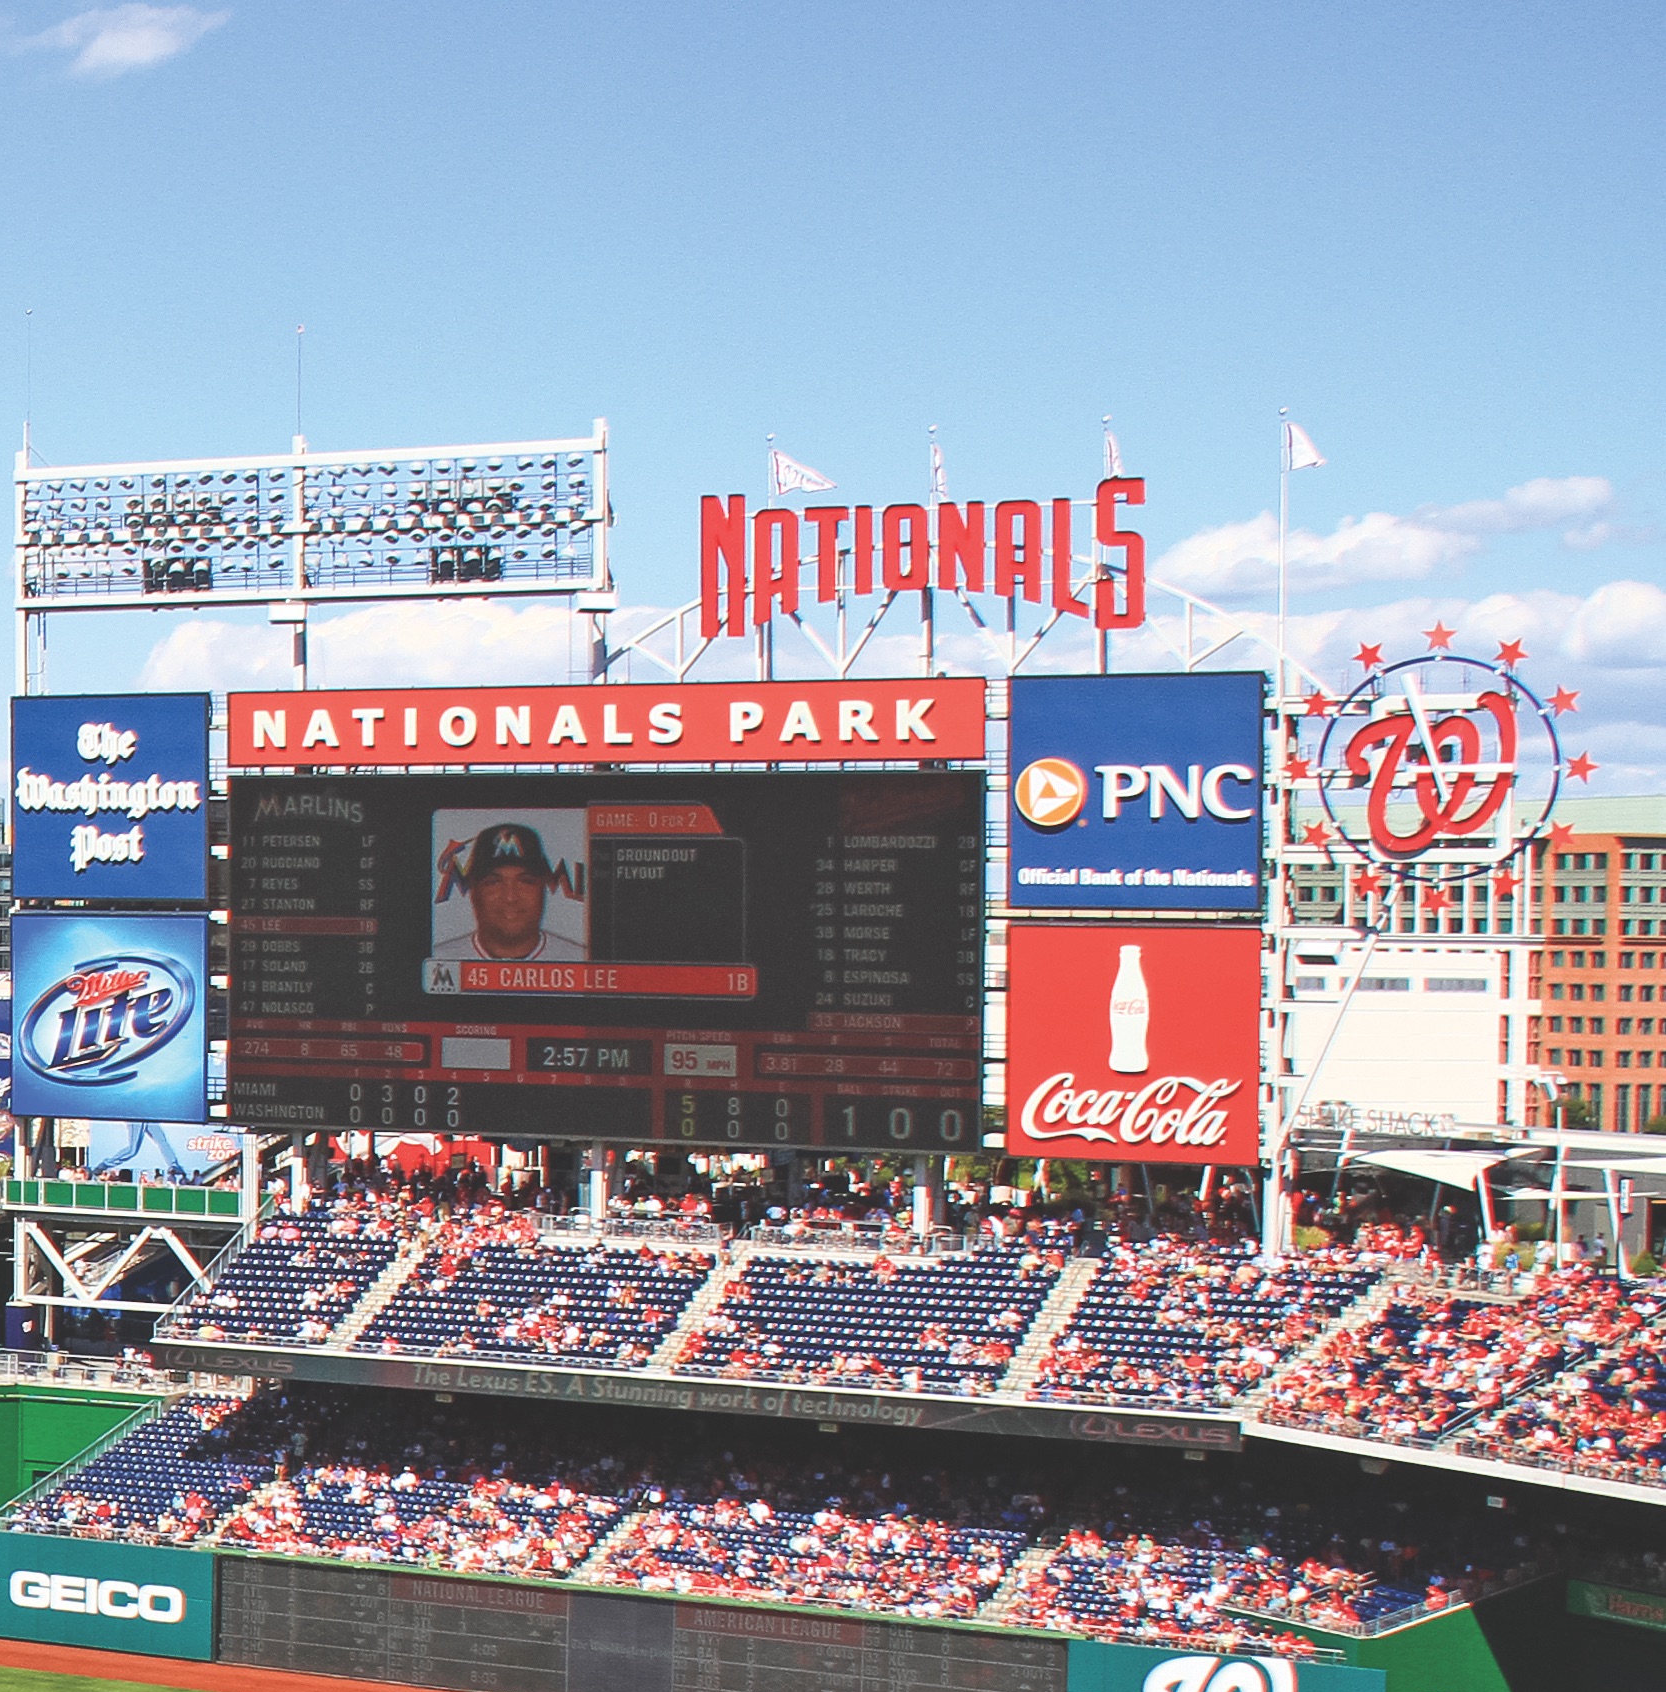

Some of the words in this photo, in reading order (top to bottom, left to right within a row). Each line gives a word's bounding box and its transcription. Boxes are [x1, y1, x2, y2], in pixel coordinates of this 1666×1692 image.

[699, 476, 1145, 638] NATIONALS
[251, 700, 684, 749] NATIONALS
[729, 698, 937, 744] PARK
[77, 722, 139, 765] The
[15, 767, 202, 819] Washington
[1093, 761, 1254, 820] PNC
[253, 792, 364, 824] MARLINS
[597, 814, 638, 828] GAME:
[649, 812, 658, 827] 0
[662, 817, 684, 828] FOR
[688, 813, 697, 828] 2
[69, 824, 145, 872] Post
[262, 835, 321, 848] PETERSEN
[616, 848, 697, 863] GROUNDOUT
[844, 859, 897, 873] HARPER
[616, 867, 665, 880] FLYOUT
[1017, 867, 1078, 886] Official
[1079, 868, 1124, 886] Bank
[1125, 869, 1144, 886] of
[1144, 869, 1171, 887] the
[1172, 869, 1256, 888] Nationals
[844, 882, 893, 896] WERTH
[262, 898, 316, 911] STANTON
[844, 904, 904, 918] LAROCHE
[67, 970, 150, 1006] Miller
[467, 969, 488, 987] 45
[499, 969, 575, 988] CARLOS
[583, 971, 618, 990] LEE
[727, 973, 749, 992] 1B
[844, 971, 909, 985] ESPINOSA
[45, 988, 174, 1071] Lite
[542, 1047, 588, 1067] 2:57
[597, 1047, 630, 1068] PM
[671, 1051, 698, 1071] 95
[705, 1059, 732, 1071] MPH
[234, 1082, 277, 1097] MIAMI
[234, 1103, 325, 1120] WASHINGTON
[681, 1096, 695, 1114] 5
[727, 1097, 741, 1116] 8
[1021, 1071, 1243, 1147] Coca-Cola
[1298, 1104, 1362, 1130] SHAKE
[1367, 1109, 1437, 1136] SHACK
[187, 1135, 233, 1152] strike
[199, 1355, 295, 1374] LEXUS
[412, 1363, 451, 1387] The
[456, 1366, 519, 1391] Lexus
[525, 1372, 559, 1395] ES.
[566, 1375, 587, 1396] A
[592, 1375, 692, 1409] Stunning
[699, 1386, 757, 1410] work
[763, 1390, 789, 1416] of
[792, 1393, 924, 1427] technology
[1114, 1419, 1233, 1444] LEXUS
[8, 1570, 185, 1623] GEICO
[412, 1582, 483, 1605] NATIONAL
[488, 1589, 545, 1610] LEAGUE
[693, 1610, 775, 1632] AMERICAN
[780, 1616, 842, 1640] LEAGUE
